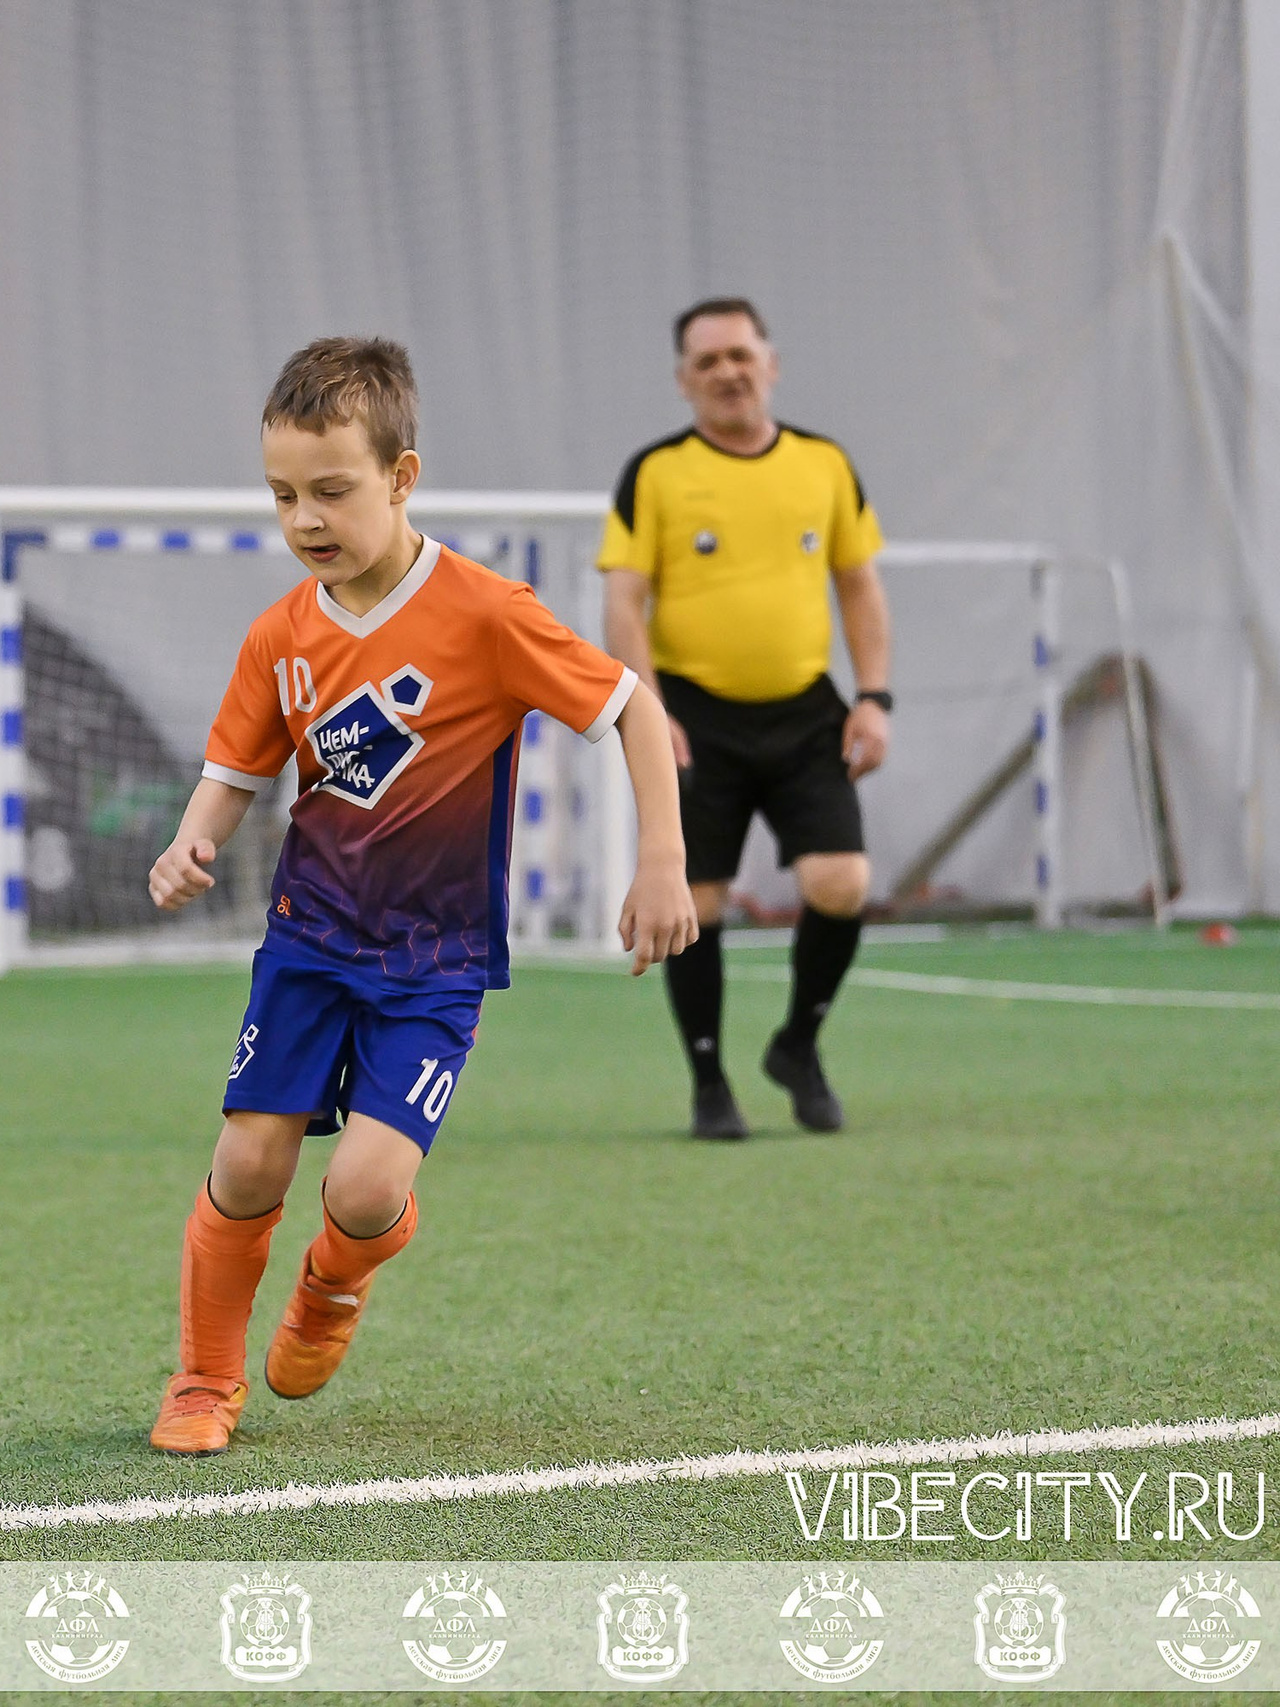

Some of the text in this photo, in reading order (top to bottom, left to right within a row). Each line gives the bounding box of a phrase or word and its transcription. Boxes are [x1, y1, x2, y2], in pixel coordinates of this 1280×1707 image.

[273, 656, 318, 716] 10
[320, 721, 370, 753] ЧЕМ-
[405, 1057, 454, 1123] 10
